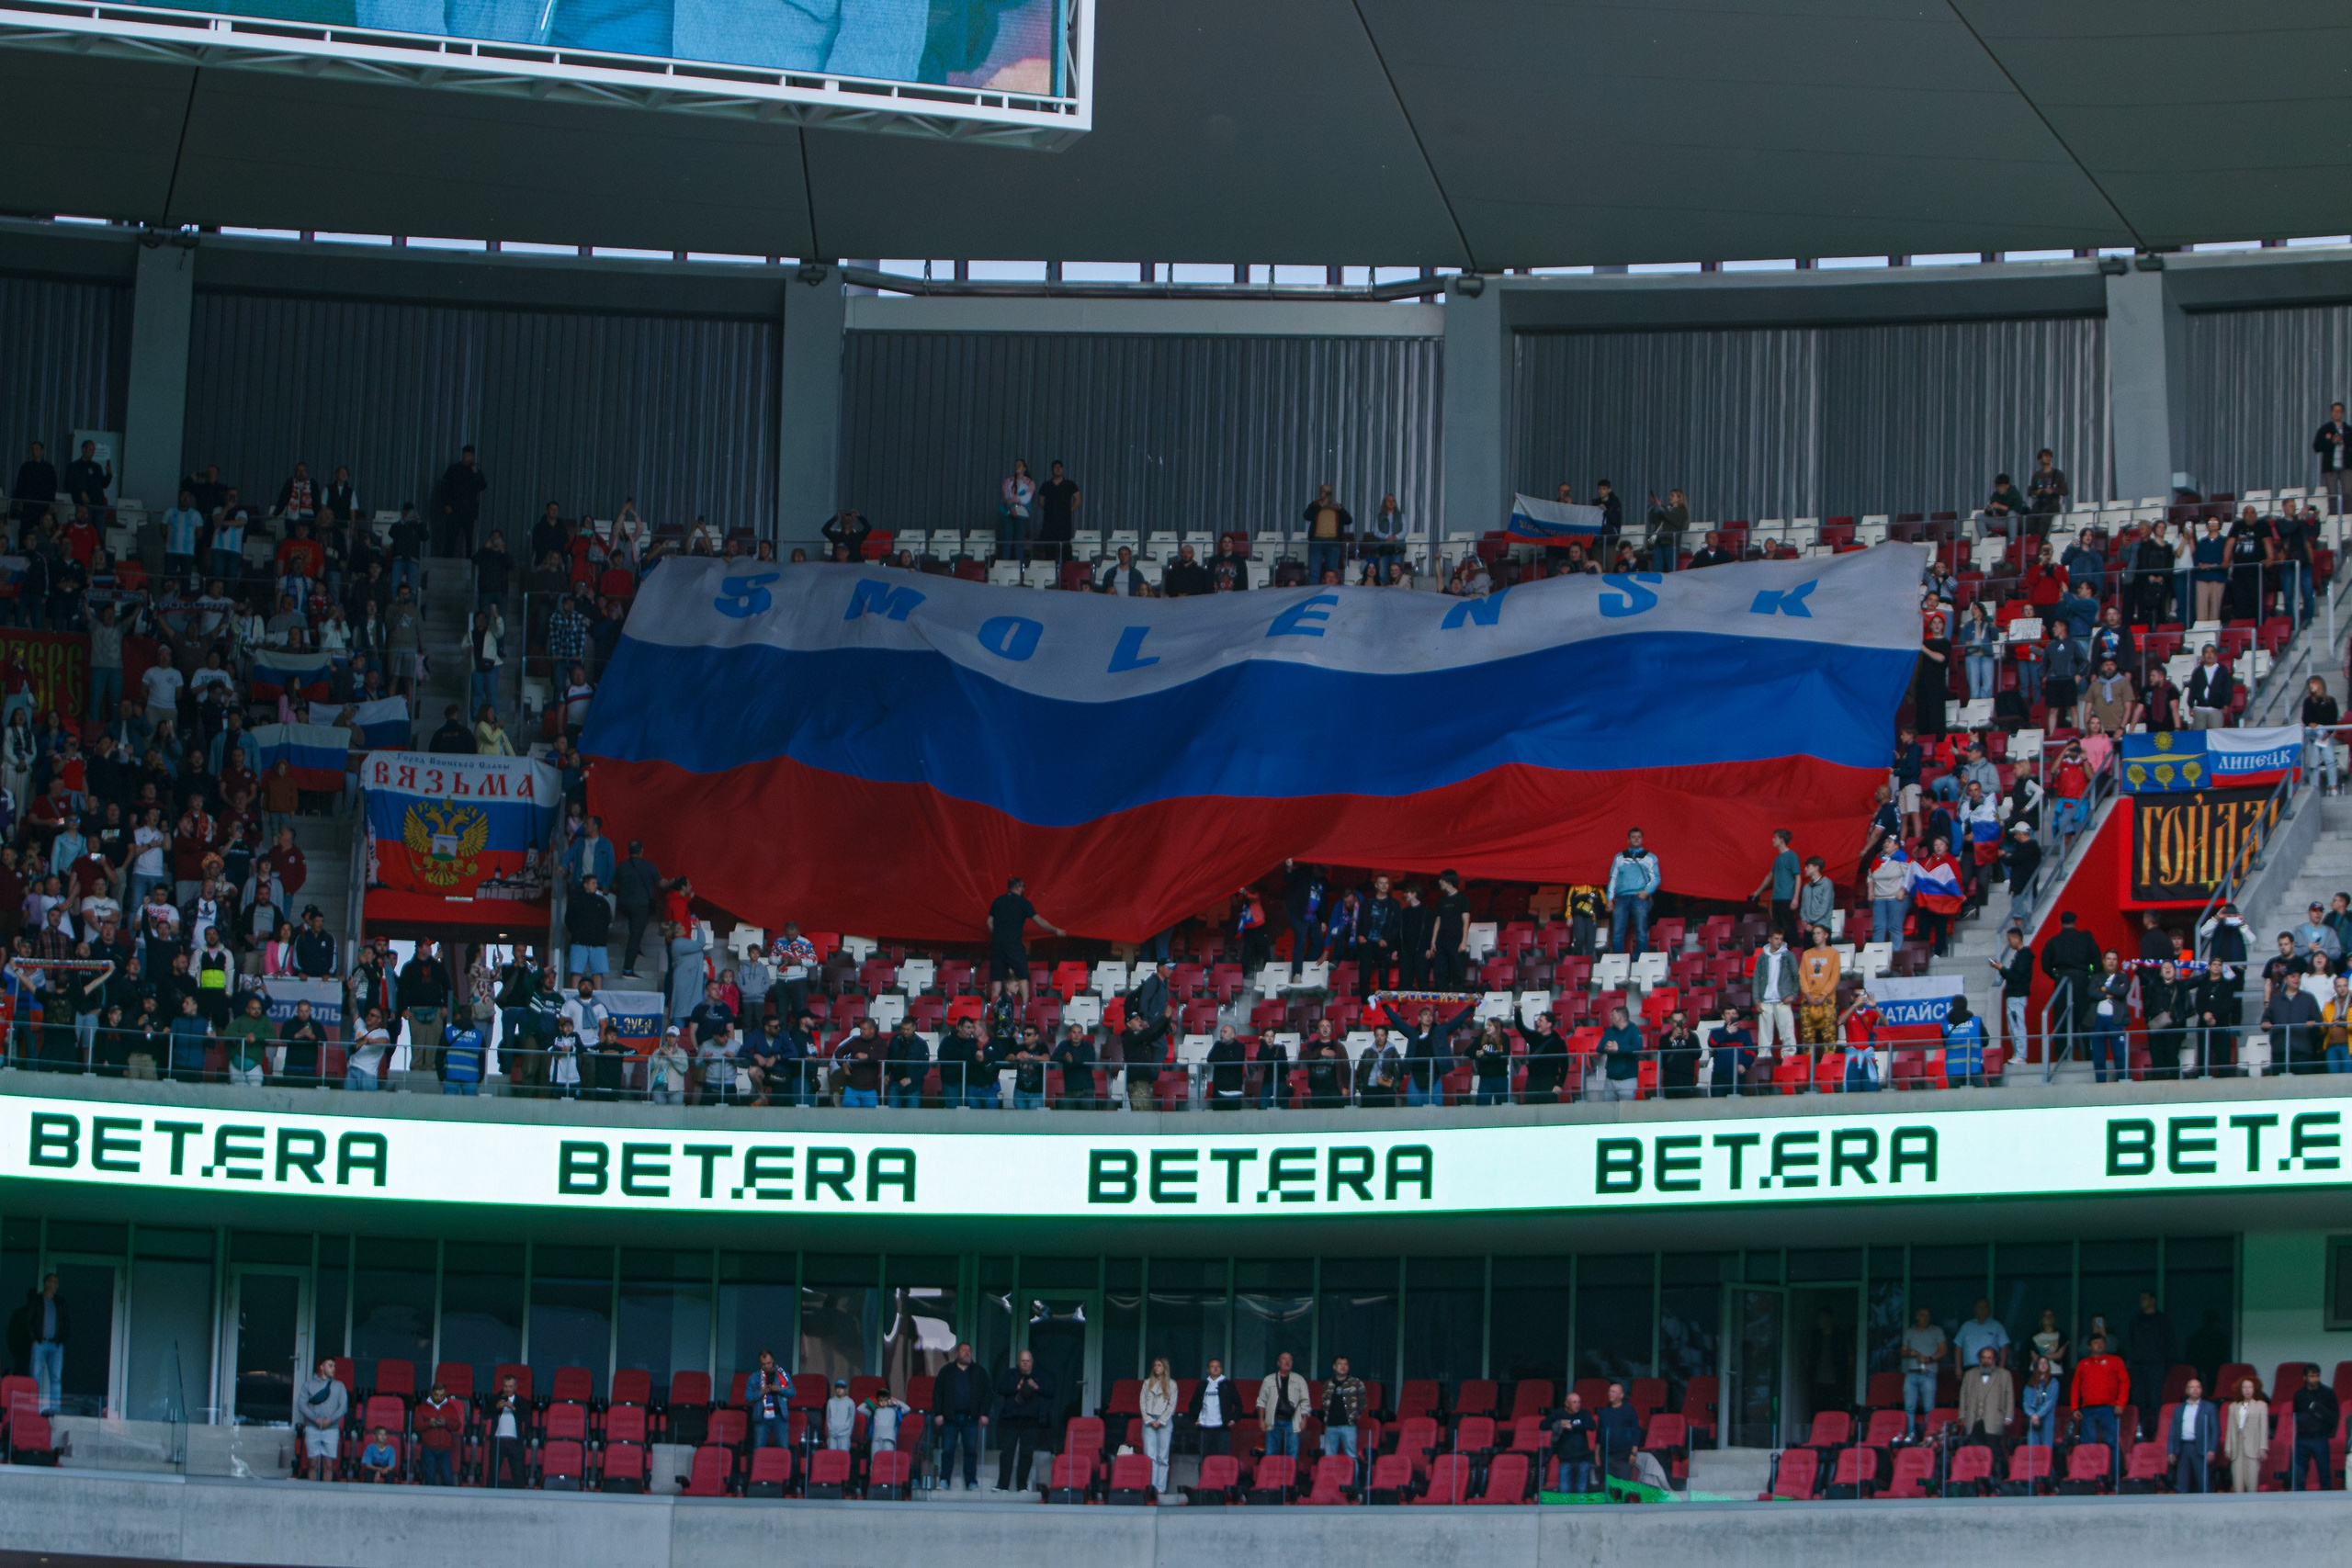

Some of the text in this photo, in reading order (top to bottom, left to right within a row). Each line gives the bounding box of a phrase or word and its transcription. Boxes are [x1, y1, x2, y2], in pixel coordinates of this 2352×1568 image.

[714, 571, 1817, 672] SMOLENSK
[2218, 749, 2291, 770] ЛИПЕЦК
[375, 761, 534, 796] ВЯЗЬМА
[1397, 992, 1459, 1003] РОССИЯ
